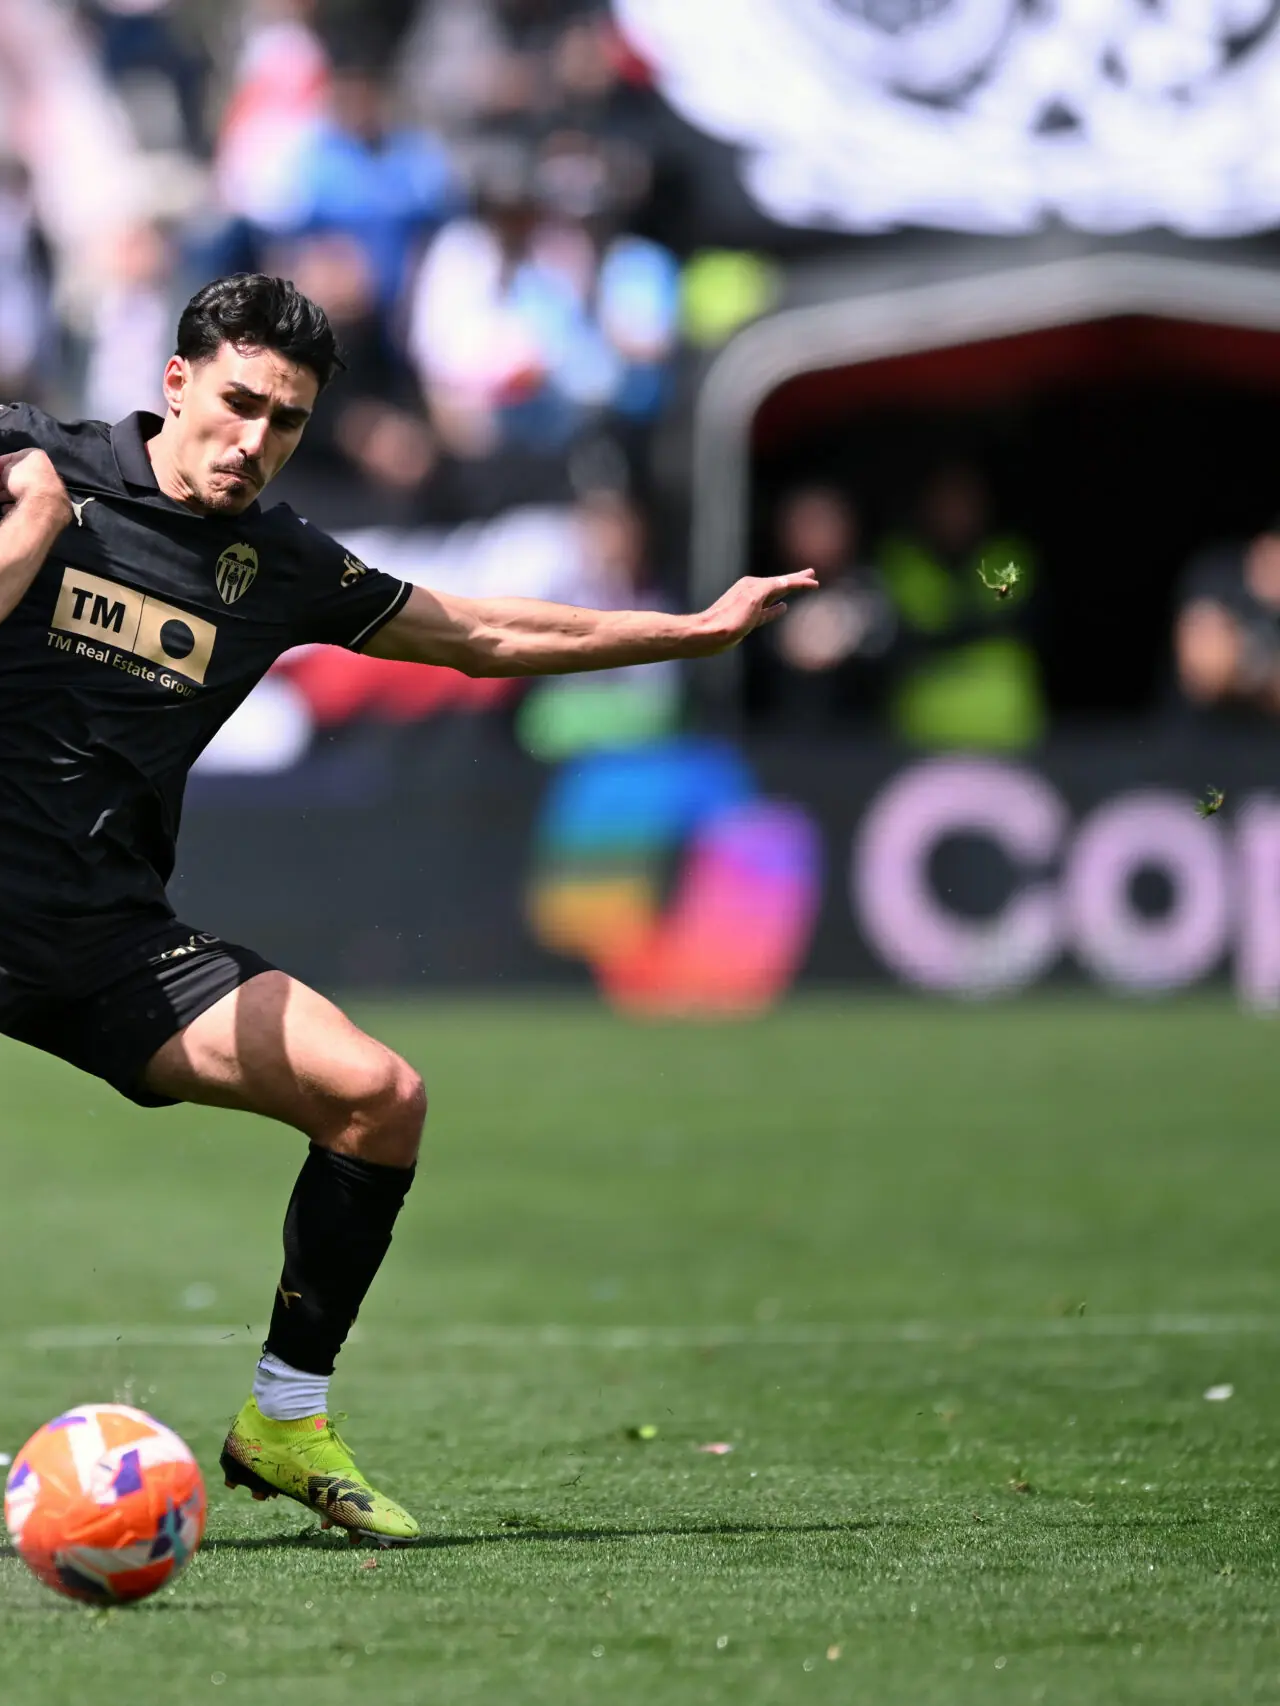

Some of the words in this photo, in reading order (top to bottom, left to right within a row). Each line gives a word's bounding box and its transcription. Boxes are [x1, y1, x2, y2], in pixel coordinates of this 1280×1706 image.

[72, 587, 126, 634] TM
[47, 632, 72, 652] TM
[75, 641, 110, 664] Real
[112, 653, 156, 682] Estate
[854, 756, 1280, 1018] Co
